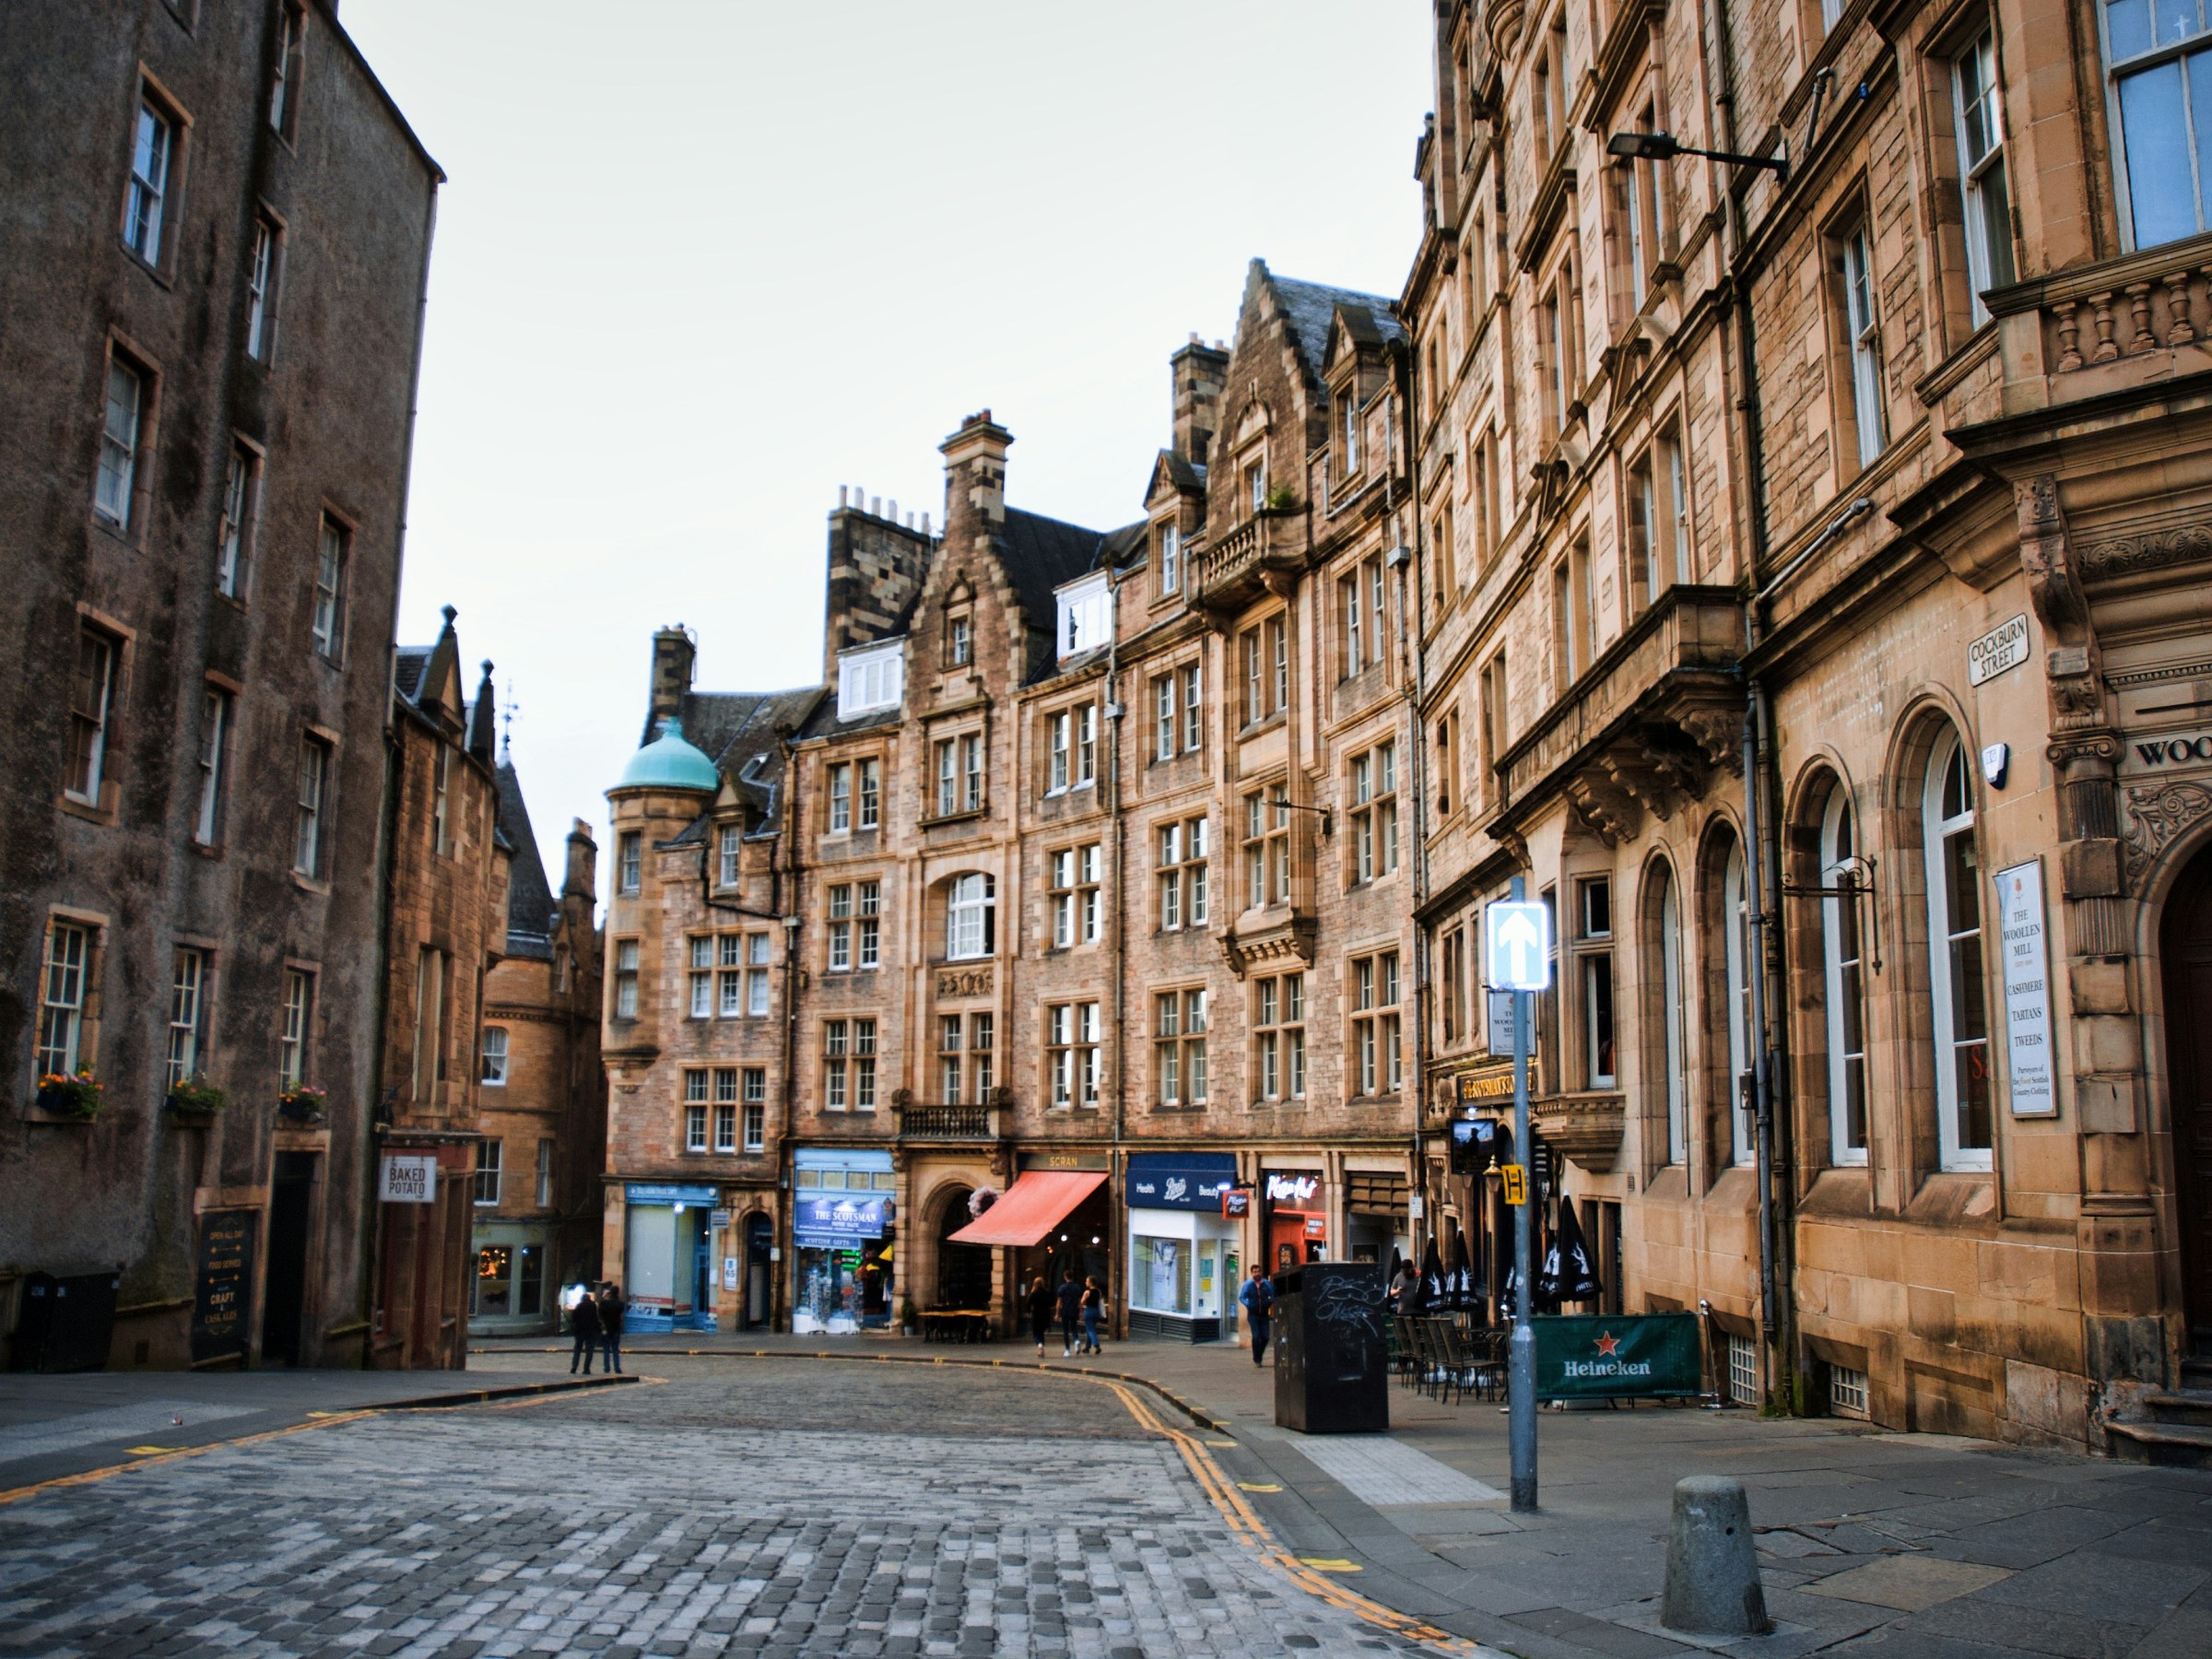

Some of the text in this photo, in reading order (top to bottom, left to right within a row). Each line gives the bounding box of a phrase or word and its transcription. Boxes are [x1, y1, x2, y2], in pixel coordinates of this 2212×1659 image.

[1971, 618, 2025, 662] COCKBURN
[1982, 644, 2015, 677] STREET
[2013, 910, 2029, 924] THE
[2004, 924, 2041, 941] WOOLLEN
[2014, 943, 2032, 957] MILL
[2007, 980, 2044, 996] CASHMERE
[2012, 1006, 2042, 1022] TARTANS
[2014, 1033, 2042, 1048] TWEEDS
[2018, 1066, 2038, 1075] Purveyors
[2031, 1075, 2049, 1084] Scottish
[2014, 1086, 2050, 1097] Country Clothing
[1049, 1156, 1077, 1167] SCRAN
[390, 1168, 426, 1182] BAKED
[389, 1182, 425, 1194] POTATO
[1135, 1182, 1155, 1194] Health
[1199, 1184, 1219, 1199] Beauty
[1266, 1175, 1318, 1200] Pizza Hut
[1227, 1194, 1247, 1206] Pizza
[815, 1210, 877, 1222] THE SCOTSMAN
[1229, 1205, 1245, 1214] Hut
[725, 1269, 735, 1278] 65
[210, 1291, 235, 1305] CRAFT
[1564, 1359, 1651, 1377] Heineken
